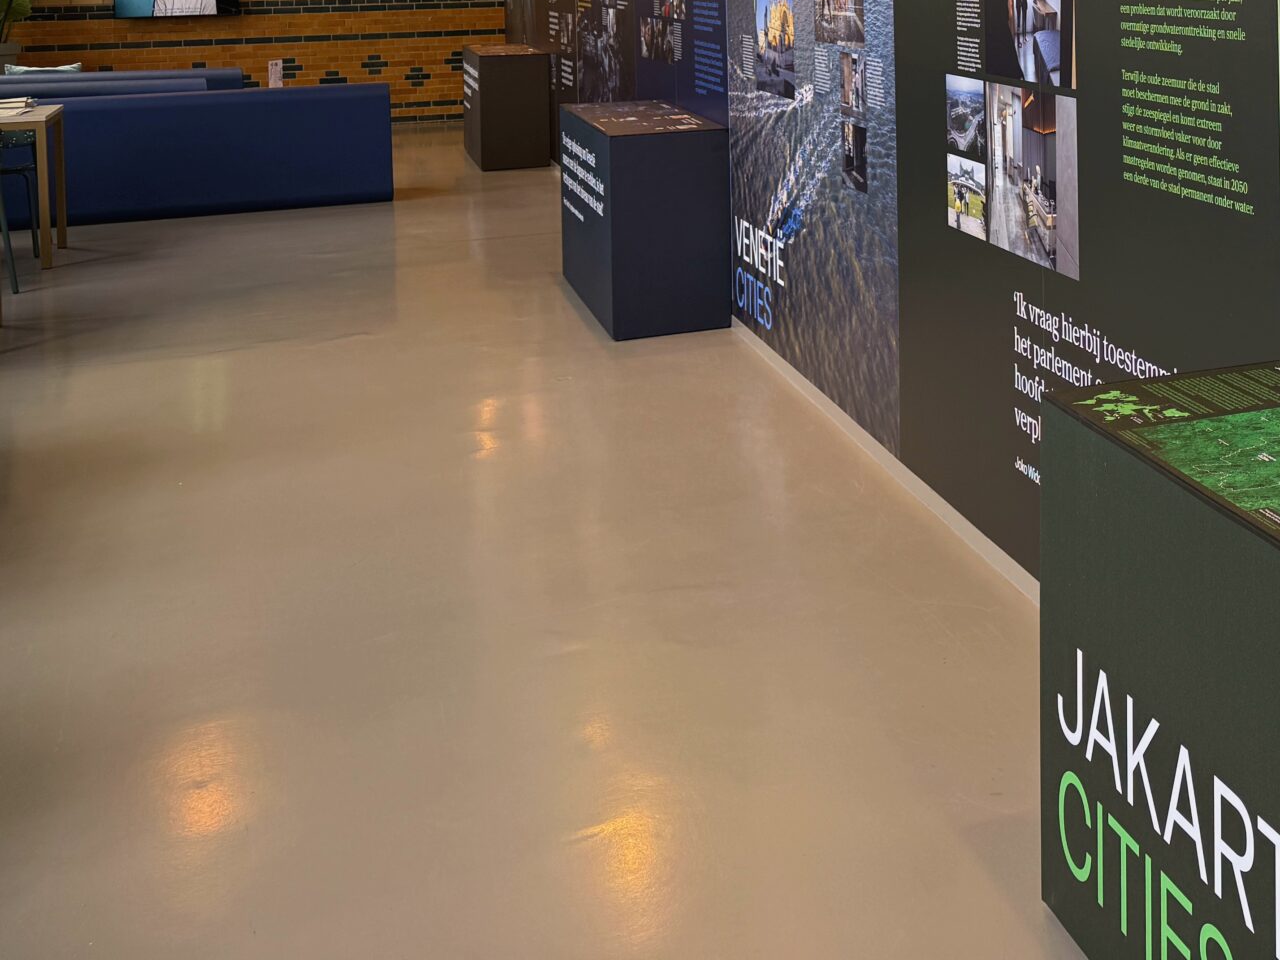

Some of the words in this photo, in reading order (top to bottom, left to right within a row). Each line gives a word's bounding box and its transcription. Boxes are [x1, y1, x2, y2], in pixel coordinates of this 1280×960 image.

[1184, 8, 1220, 20] veroorzaakt
[1220, 8, 1237, 21] door
[1226, 28, 1246, 40] snelle
[1206, 82, 1220, 94] stad
[1217, 102, 1232, 118] zakt,
[1196, 118, 1222, 132] extreem
[1206, 136, 1222, 150] door
[1208, 156, 1240, 174] effectieve
[1230, 178, 1248, 194] 2050
[1214, 195, 1234, 210] onder
[1234, 202, 1255, 215] water.
[734, 216, 785, 287] VENETIË
[735, 266, 774, 331] CITIES
[1028, 304, 1059, 342] vraag
[1061, 312, 1100, 364] hierbij
[1014, 326, 1032, 360] het
[1033, 346, 1093, 388] parlement
[1014, 456, 1028, 476] Joko
